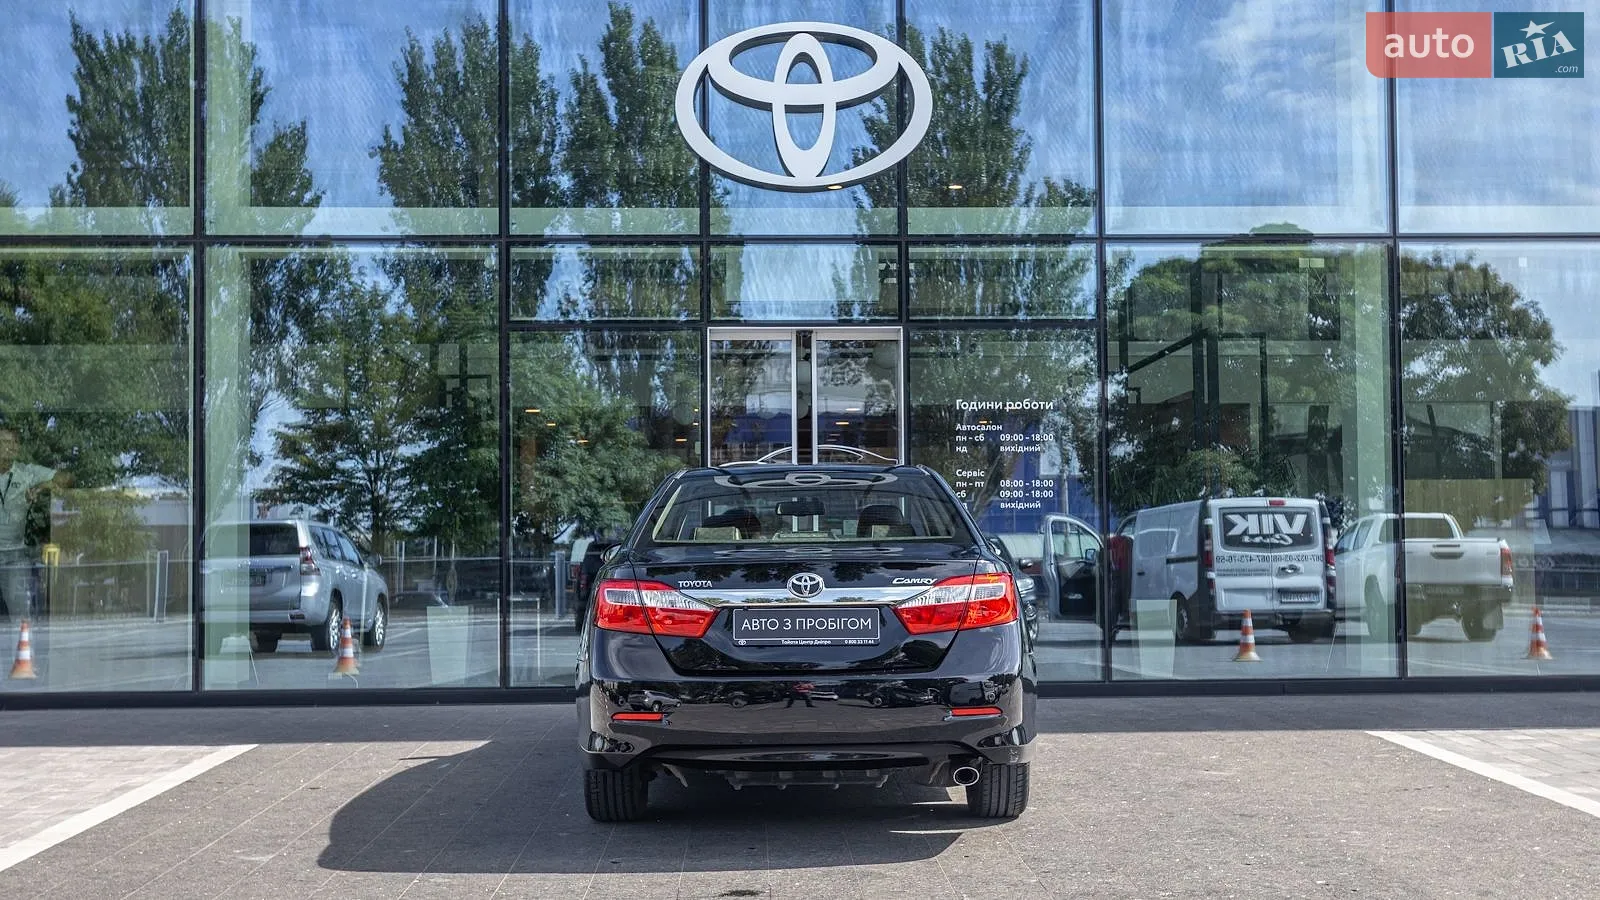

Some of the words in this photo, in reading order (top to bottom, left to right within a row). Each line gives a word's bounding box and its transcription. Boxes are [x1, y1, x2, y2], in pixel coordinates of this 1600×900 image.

[956, 400, 1003, 411] Години
[1005, 399, 1054, 412] роботи
[955, 423, 1003, 431] Автосалон
[1000, 433, 1024, 441] 09:00
[1031, 433, 1054, 441] 18:00
[956, 445, 968, 453] нд
[1000, 444, 1041, 453] вихідний
[956, 469, 985, 478] Сервіс
[1000, 480, 1024, 488] 08:00
[1031, 480, 1054, 488] 18:00
[956, 490, 967, 498] сб
[1000, 490, 1024, 498] 09:00
[1031, 490, 1054, 498] 18:00
[1000, 501, 1041, 510] вихідний
[678, 580, 713, 588] TOYOTA
[741, 618, 779, 631] АВТО
[783, 618, 792, 630] З
[796, 617, 872, 631] ПРОБІГОМ
